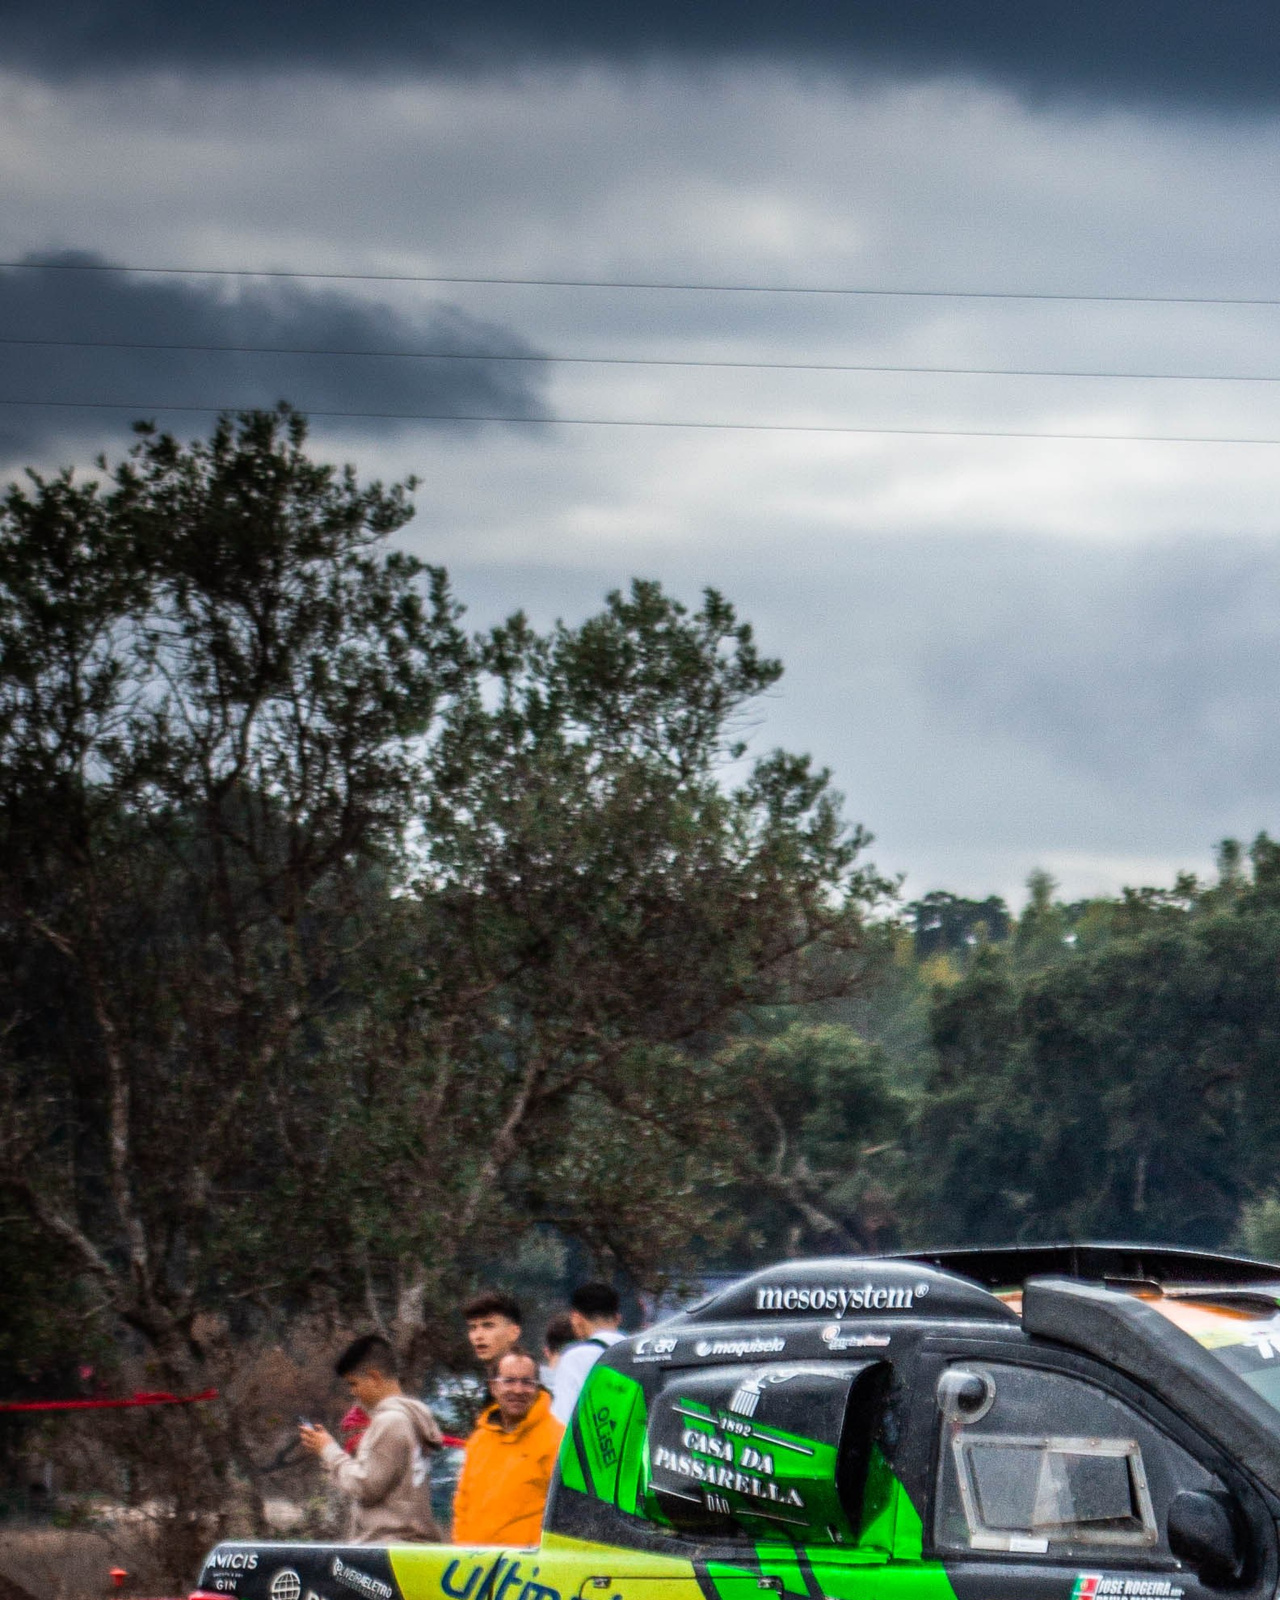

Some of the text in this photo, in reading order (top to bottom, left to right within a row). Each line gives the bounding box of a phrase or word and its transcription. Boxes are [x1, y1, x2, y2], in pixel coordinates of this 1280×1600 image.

[720, 1417, 752, 1437] 1892
[682, 1429, 775, 1475] CASA DA
[653, 1446, 805, 1508] PASSARELLA
[207, 1553, 259, 1569] AMICIS
[216, 1580, 237, 1591] GIN
